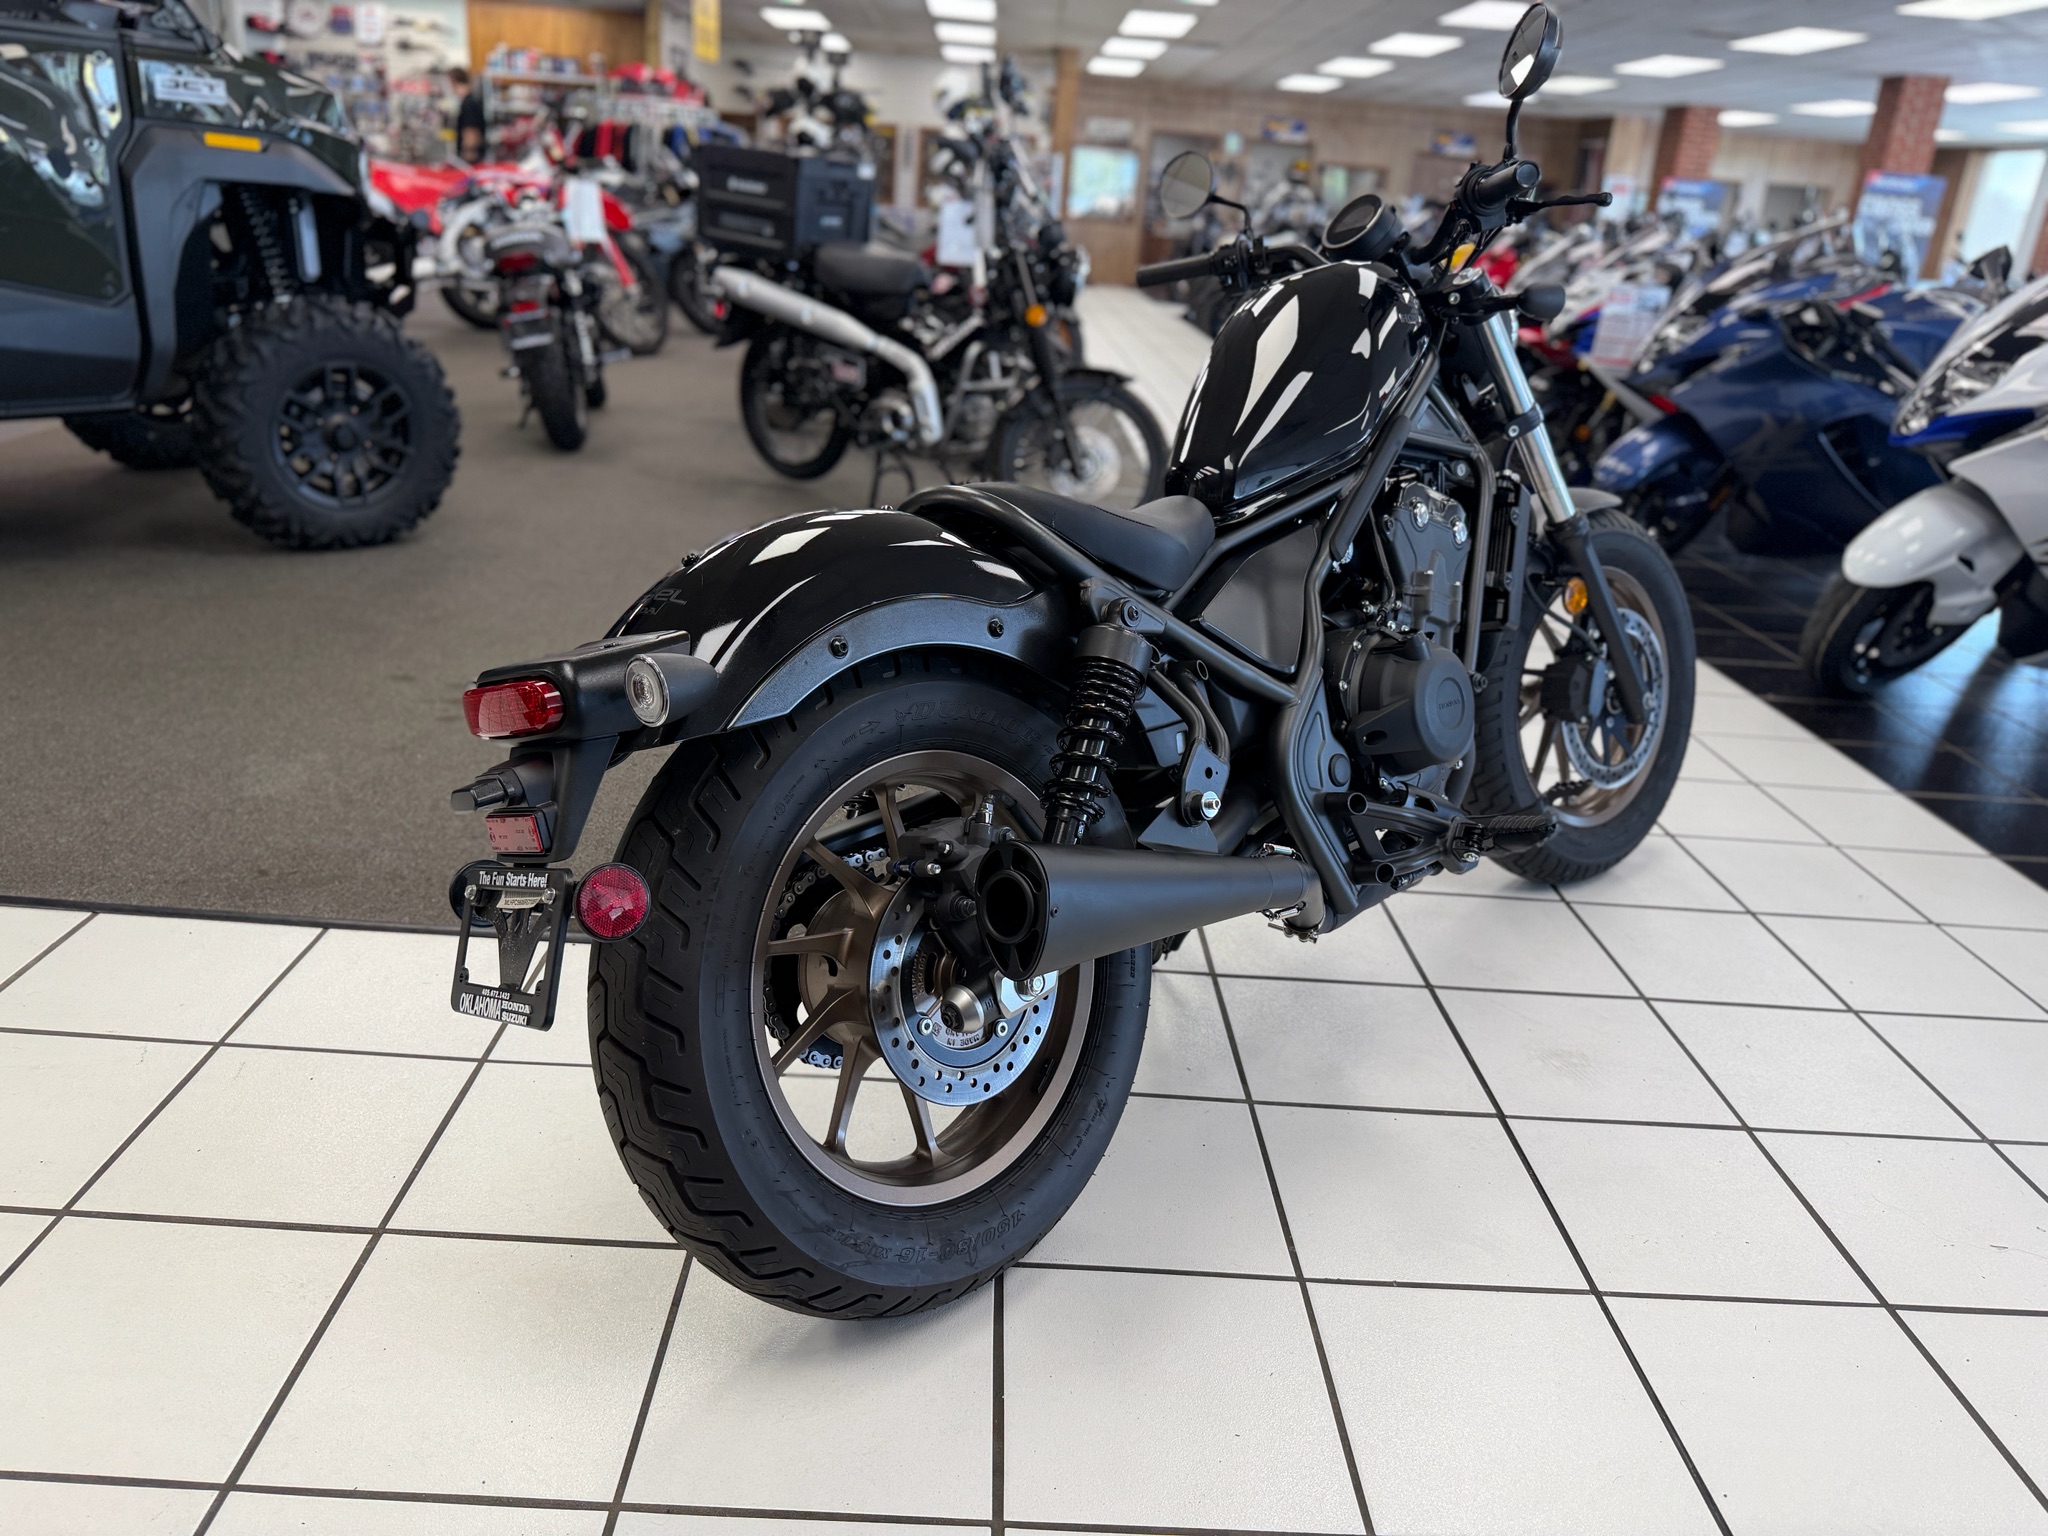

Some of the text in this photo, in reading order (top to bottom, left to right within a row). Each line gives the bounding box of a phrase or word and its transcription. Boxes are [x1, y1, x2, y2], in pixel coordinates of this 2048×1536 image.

[912, 701, 1043, 743] DUNLOP
[479, 870, 549, 888] The Fun Starts Here!
[459, 992, 501, 1020] OKLAHOMA
[501, 1000, 531, 1014] HONDA
[501, 1011, 528, 1026] SUZUKI
